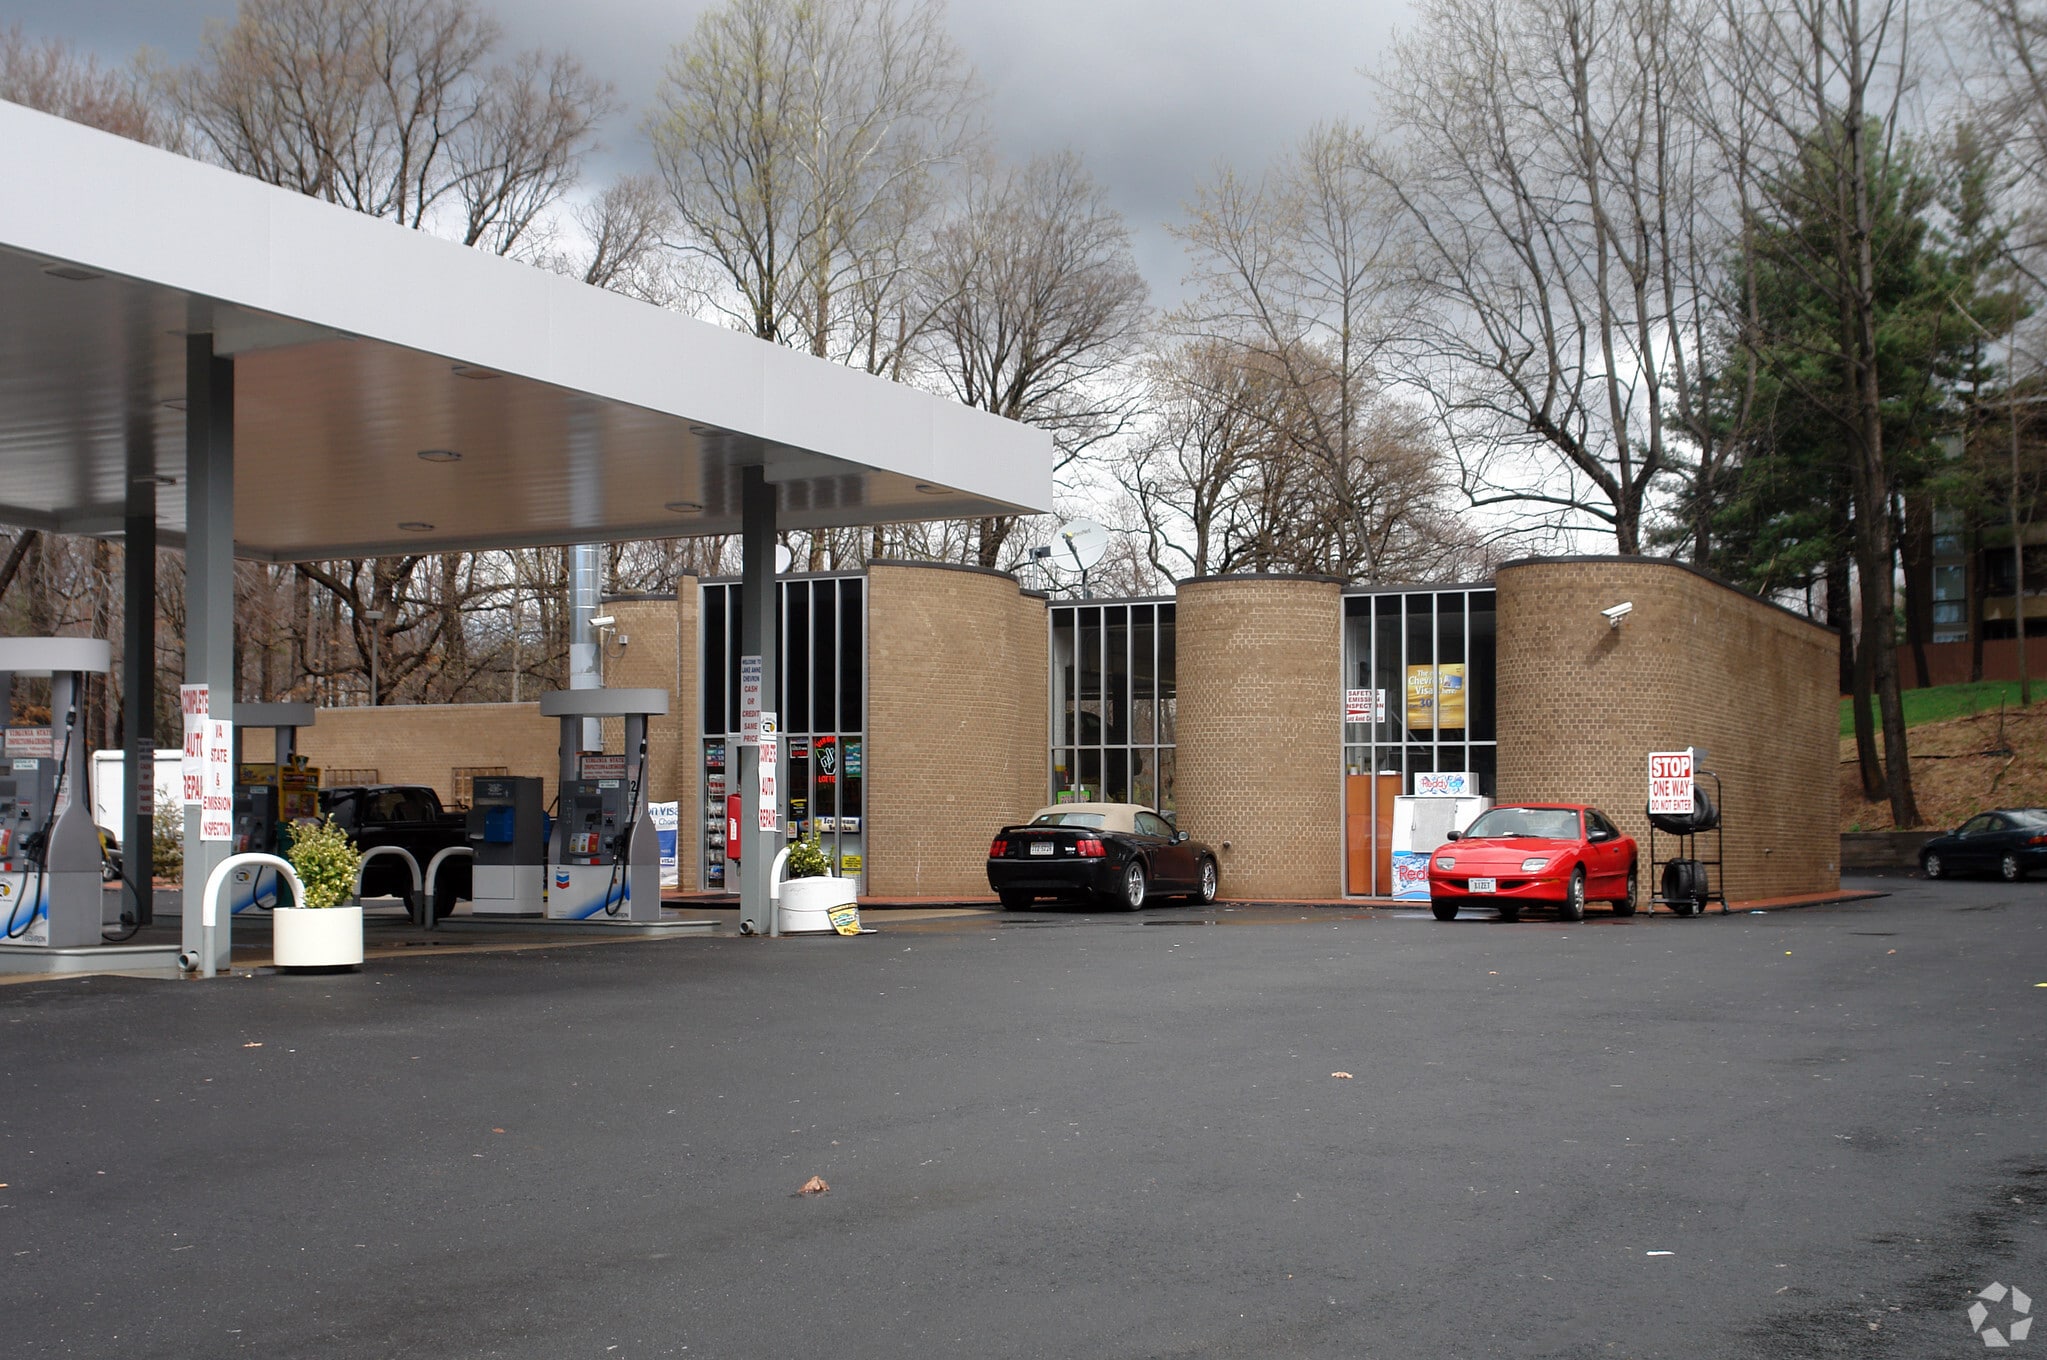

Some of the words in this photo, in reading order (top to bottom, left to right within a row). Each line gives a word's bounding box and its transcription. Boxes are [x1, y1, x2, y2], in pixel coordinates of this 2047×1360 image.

[1408, 676, 1443, 685] Chevrn
[210, 748, 227, 762] STATE
[1652, 757, 1690, 777] STOP
[630, 780, 637, 792] 2
[762, 778, 774, 796] AUTO
[1422, 778, 1448, 789] Reddy
[1653, 780, 1670, 796] ONE
[1672, 780, 1690, 796] WAY
[203, 796, 231, 810] EMISSION
[1652, 800, 1659, 810] DO
[1660, 800, 1672, 810] NOT
[1674, 800, 1692, 810] ENTER
[760, 810, 776, 828] REPAIR
[203, 822, 230, 836] NSPECTION
[1400, 866, 1428, 880] Red
